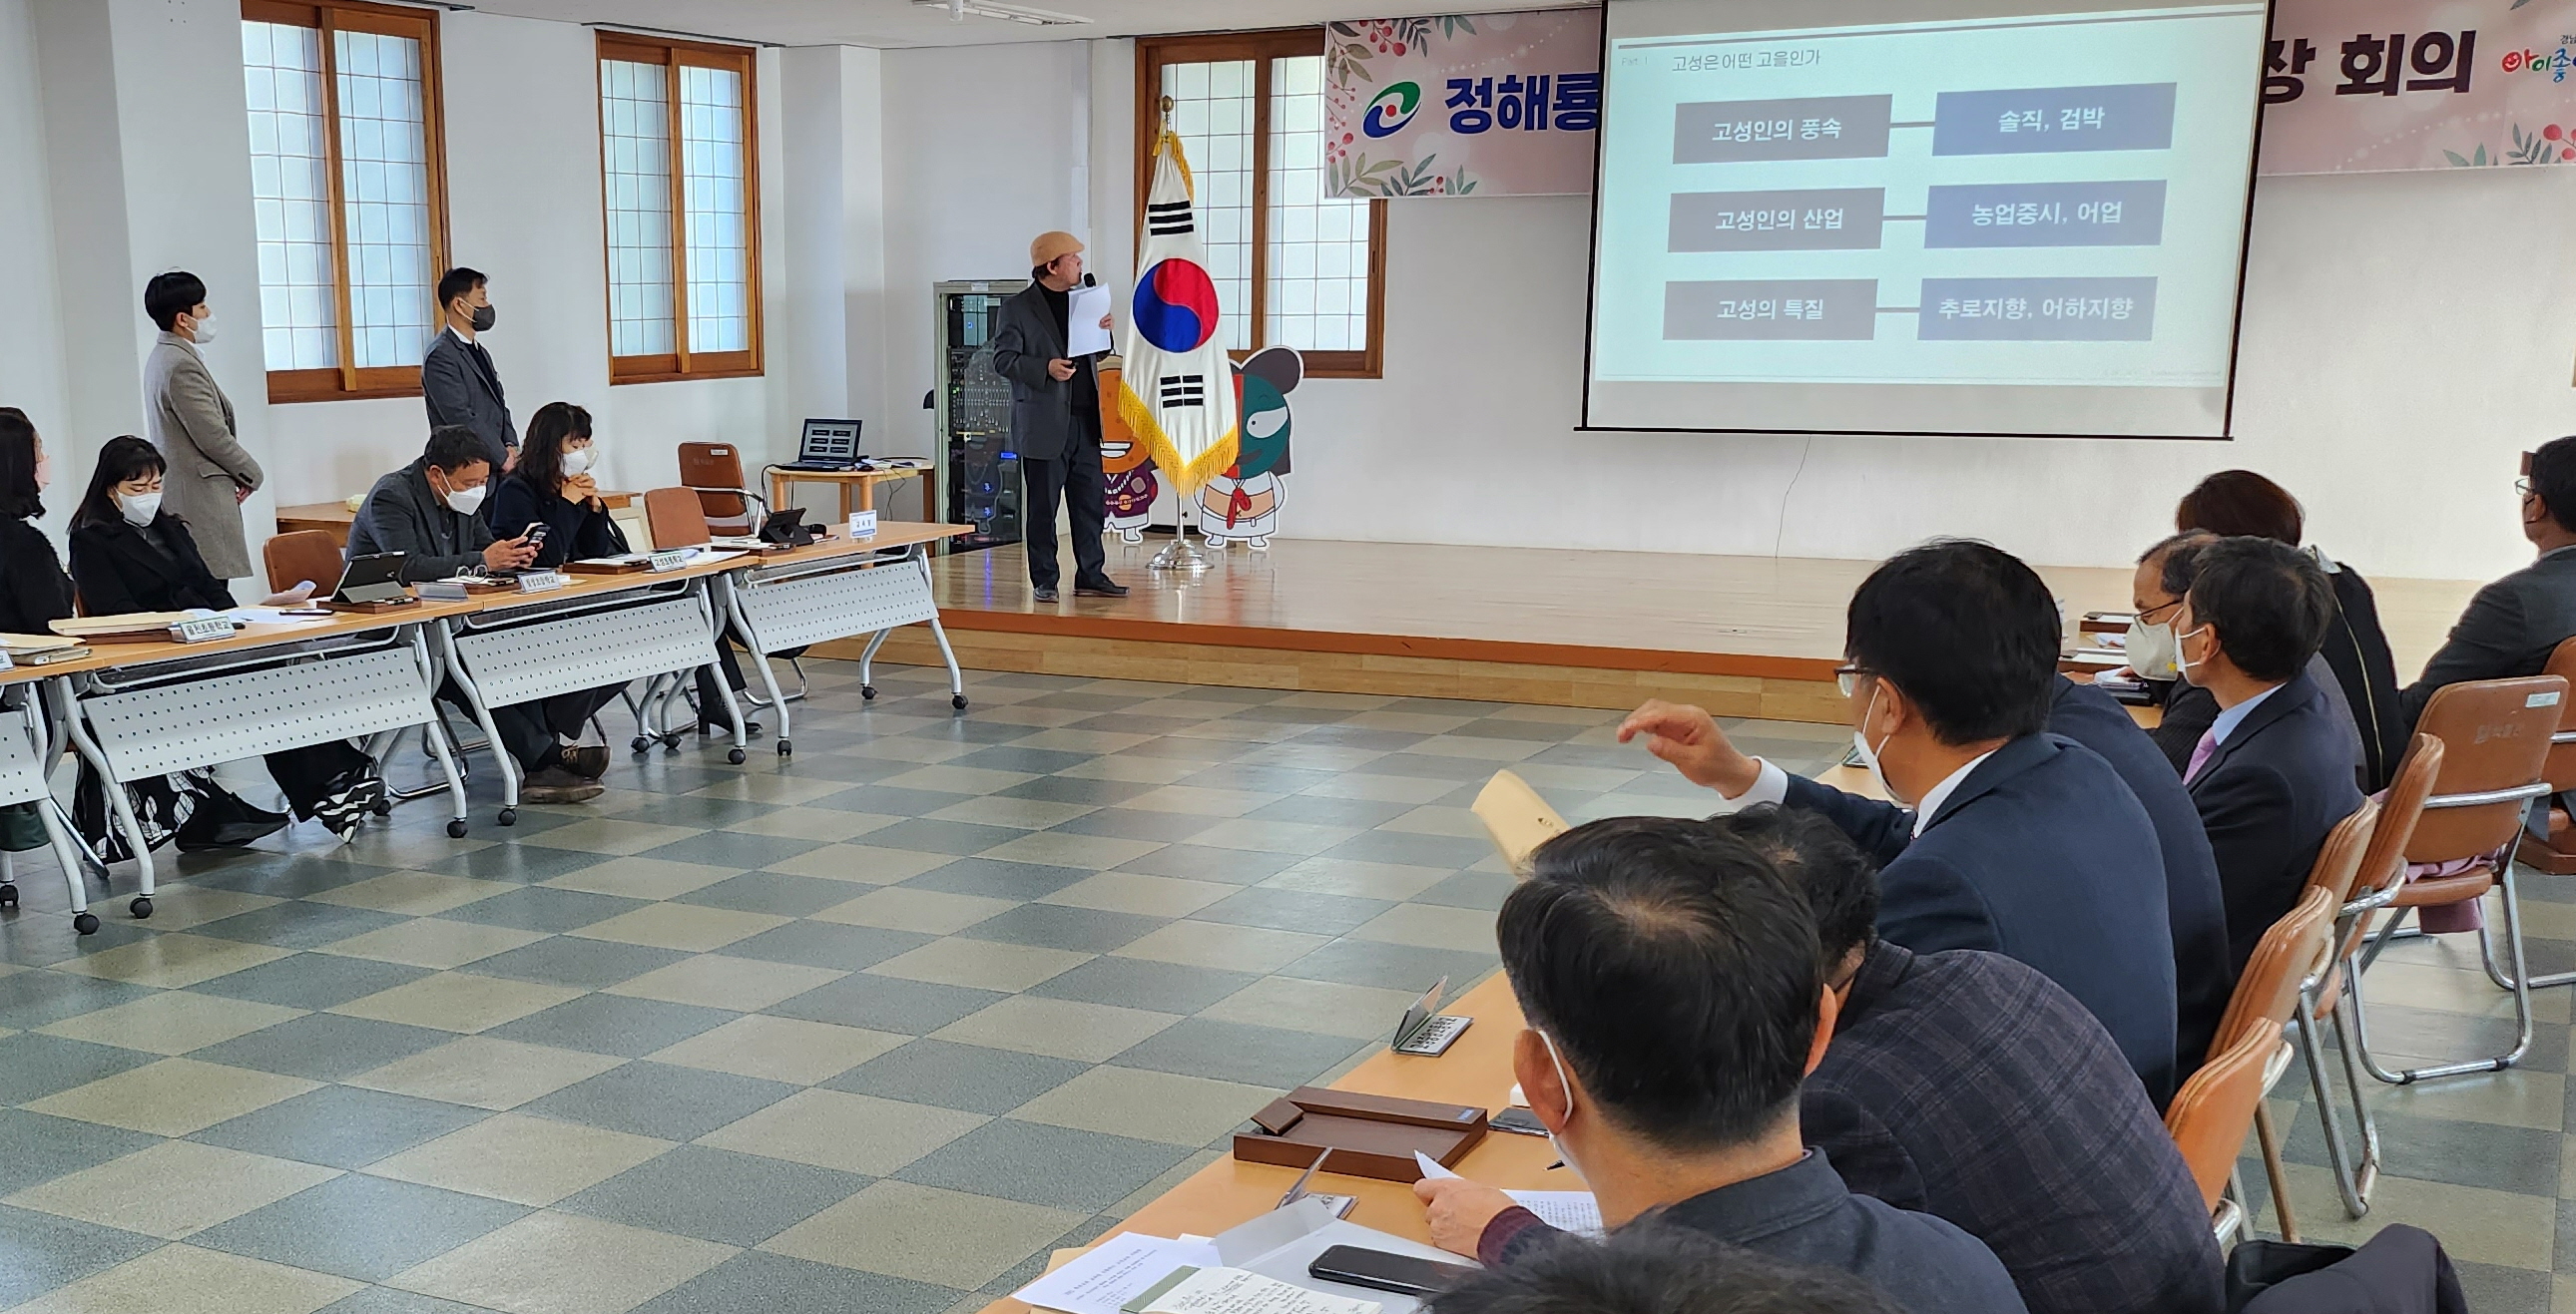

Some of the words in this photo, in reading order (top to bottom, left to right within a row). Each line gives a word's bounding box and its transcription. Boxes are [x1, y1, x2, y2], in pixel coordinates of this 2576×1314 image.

[1672, 55, 1719, 72] 고성은
[1722, 53, 1753, 70] 어떤
[1757, 49, 1821, 68] 고을인가
[2335, 30, 2477, 97] 회의
[2501, 48, 2576, 84] 아이좋
[1712, 119, 1794, 142] 고성인의
[1800, 117, 1841, 140] 풍속
[1998, 109, 2049, 133] 솔직,
[2059, 106, 2106, 131] 검박
[1715, 209, 1796, 231] 고성인의
[1803, 208, 1843, 230] 산업
[1971, 202, 2068, 226] 농업중시,
[2077, 201, 2123, 224] 어업
[1717, 298, 1777, 320] 고성의
[1784, 298, 1824, 320] 특질
[1938, 297, 2033, 321] 추로지향,
[2042, 296, 2134, 320] 어하지향
